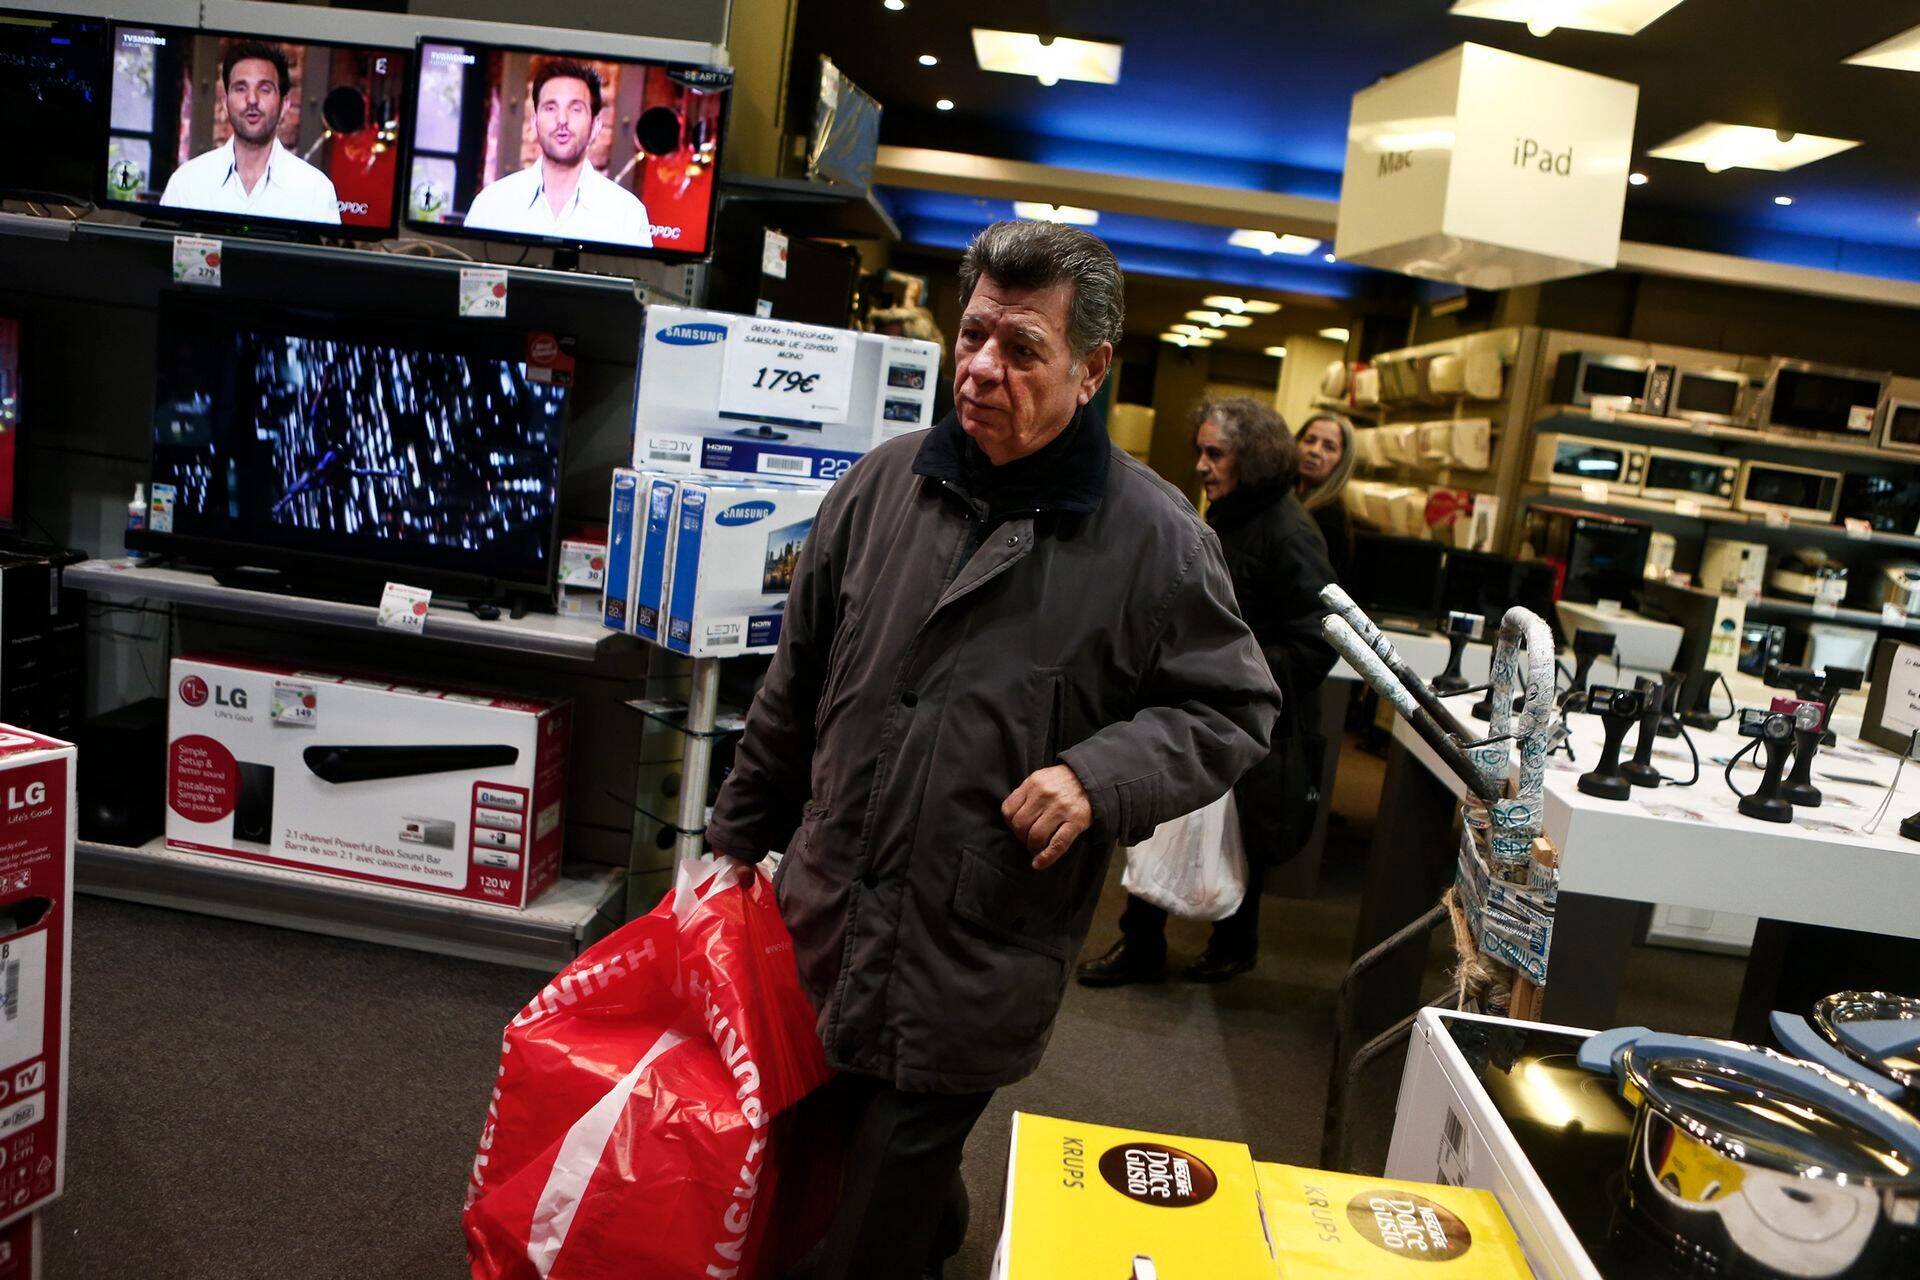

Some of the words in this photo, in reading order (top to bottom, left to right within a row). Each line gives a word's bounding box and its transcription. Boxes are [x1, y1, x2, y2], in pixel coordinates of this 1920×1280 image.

[1377, 150, 1414, 178] Mac
[1512, 138, 1573, 177] iPad
[664, 326, 726, 343] SAMSUNG
[752, 367, 820, 393] 179€
[722, 507, 770, 520] SAMSUNG
[215, 685, 248, 709] LG
[177, 744, 209, 758] Simple
[177, 755, 205, 768] Setup
[205, 759, 213, 768] &
[177, 779, 226, 794] Installation
[202, 770, 225, 780] sound
[8, 781, 46, 811] LG
[177, 789, 207, 803] Simple
[207, 794, 215, 803] &
[31, 807, 53, 819] Good
[286, 828, 298, 839] 2.1
[300, 832, 333, 846] channel
[334, 837, 373, 853] Powerful
[374, 845, 395, 857] Bass
[397, 848, 424, 862] Sound
[426, 855, 441, 865] Bar
[284, 840, 308, 852] Barre
[310, 846, 321, 855] de
[322, 849, 338, 858] son
[339, 849, 353, 860] 2.1
[355, 854, 375, 865] avec
[377, 857, 409, 870] caisson
[411, 862, 423, 872] de
[424, 865, 454, 878] basses
[479, 876, 498, 888] 120
[499, 879, 511, 890] W
[18, 1067, 38, 1088] TV
[1063, 1136, 1085, 1189] KRUPS
[1145, 1150, 1175, 1198] Dolce
[1305, 1184, 1341, 1243] KRUPS
[1388, 1199, 1428, 1252] Dolce
